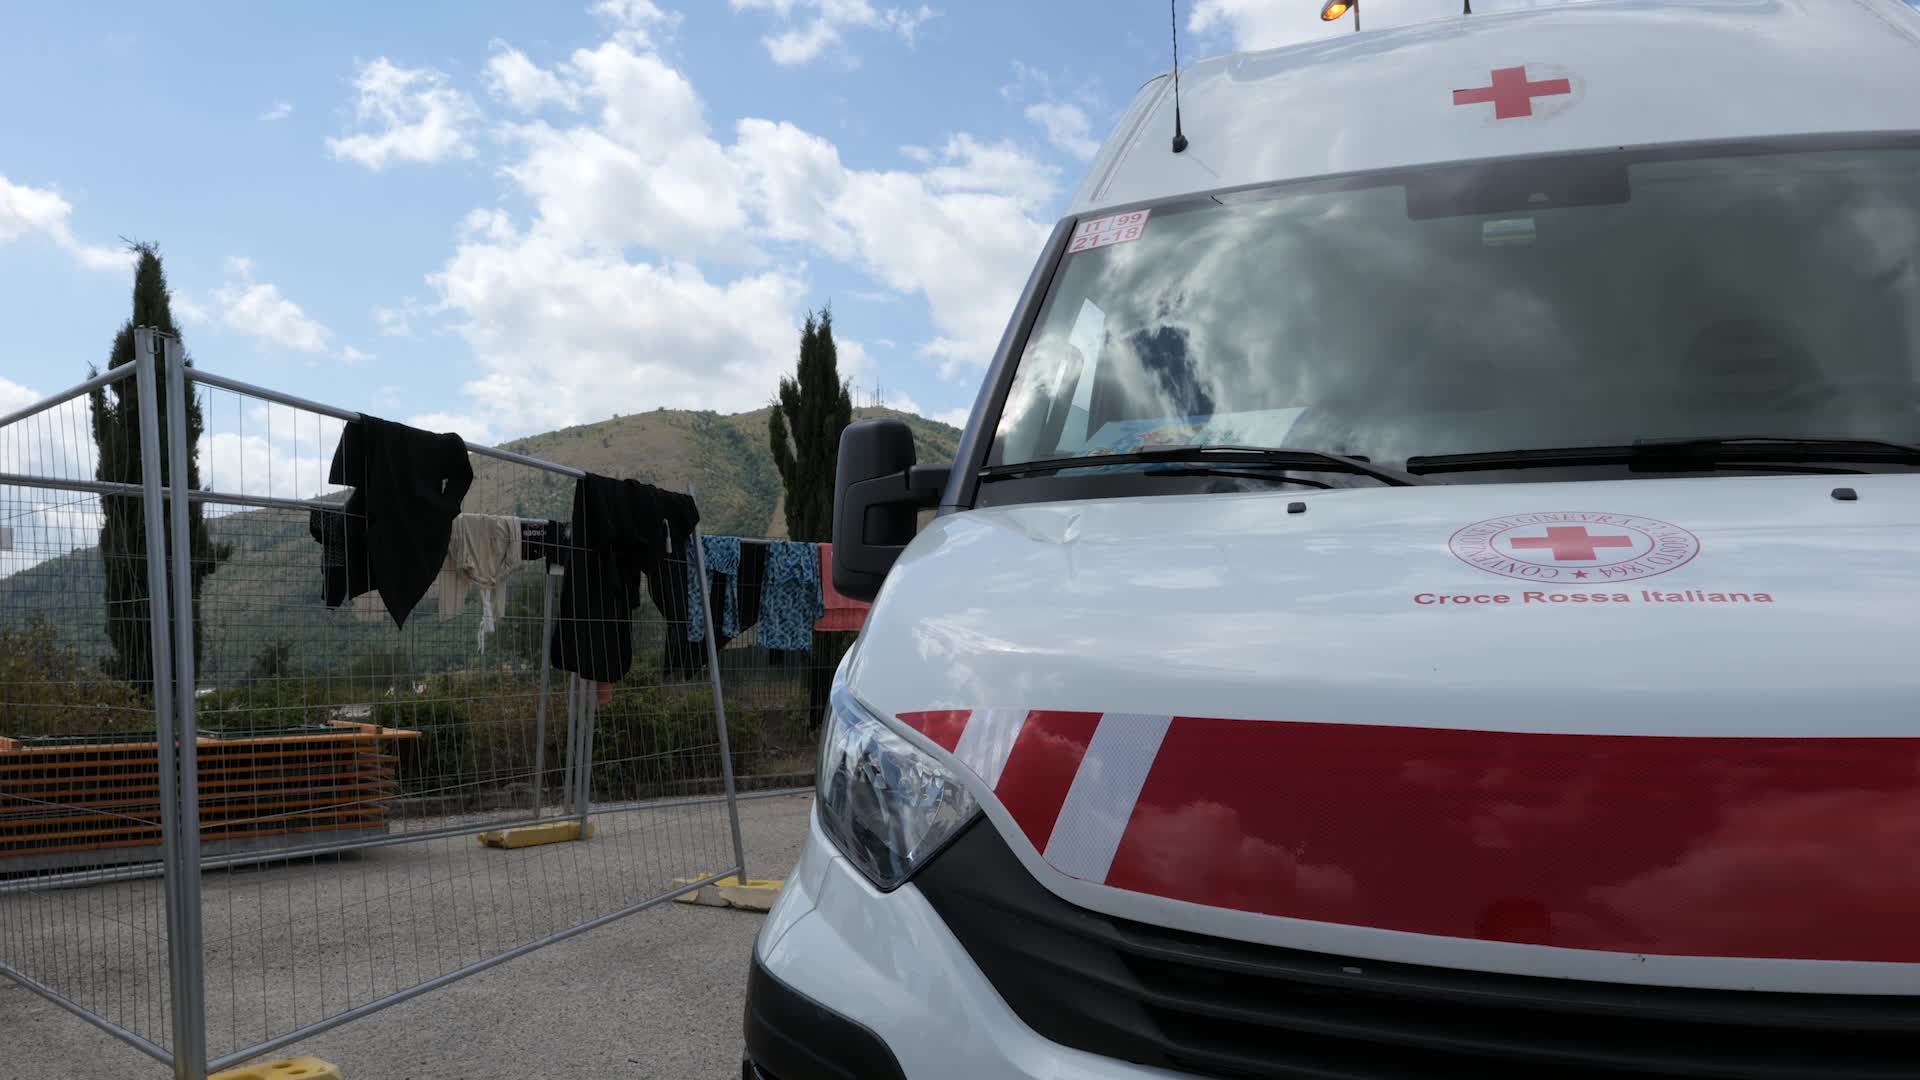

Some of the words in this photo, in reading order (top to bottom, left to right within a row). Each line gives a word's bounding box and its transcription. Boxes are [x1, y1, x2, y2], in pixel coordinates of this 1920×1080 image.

[1086, 221, 1105, 233] IT
[1119, 213, 1142, 226] 99
[1074, 227, 1138, 250] 21-18
[1598, 560, 1656, 578] 1864
[1414, 593, 1510, 605] Croce
[1523, 591, 1630, 603] Rossa
[1641, 590, 1773, 603] Italiana
